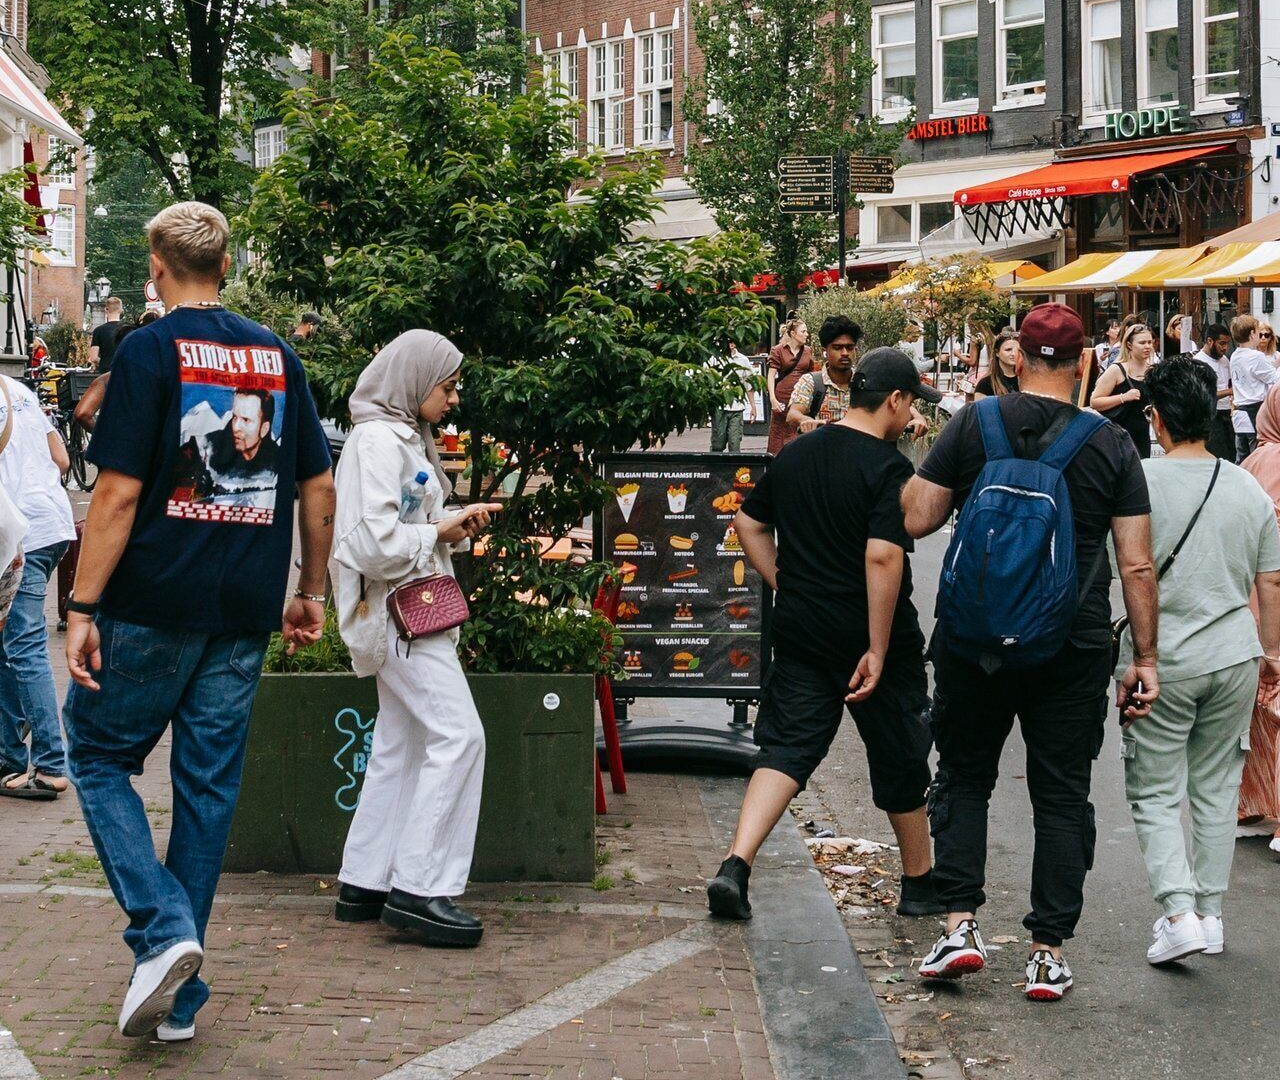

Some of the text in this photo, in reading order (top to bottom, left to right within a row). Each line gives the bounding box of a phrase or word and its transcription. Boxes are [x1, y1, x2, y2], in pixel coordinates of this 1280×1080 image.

[906, 114, 988, 139] AMSTEL BIER
[1105, 106, 1185, 139] HOPPE
[1009, 189, 1022, 198] Café
[1023, 188, 1041, 198] Hoppe
[180, 342, 283, 376] SIMPLY RED
